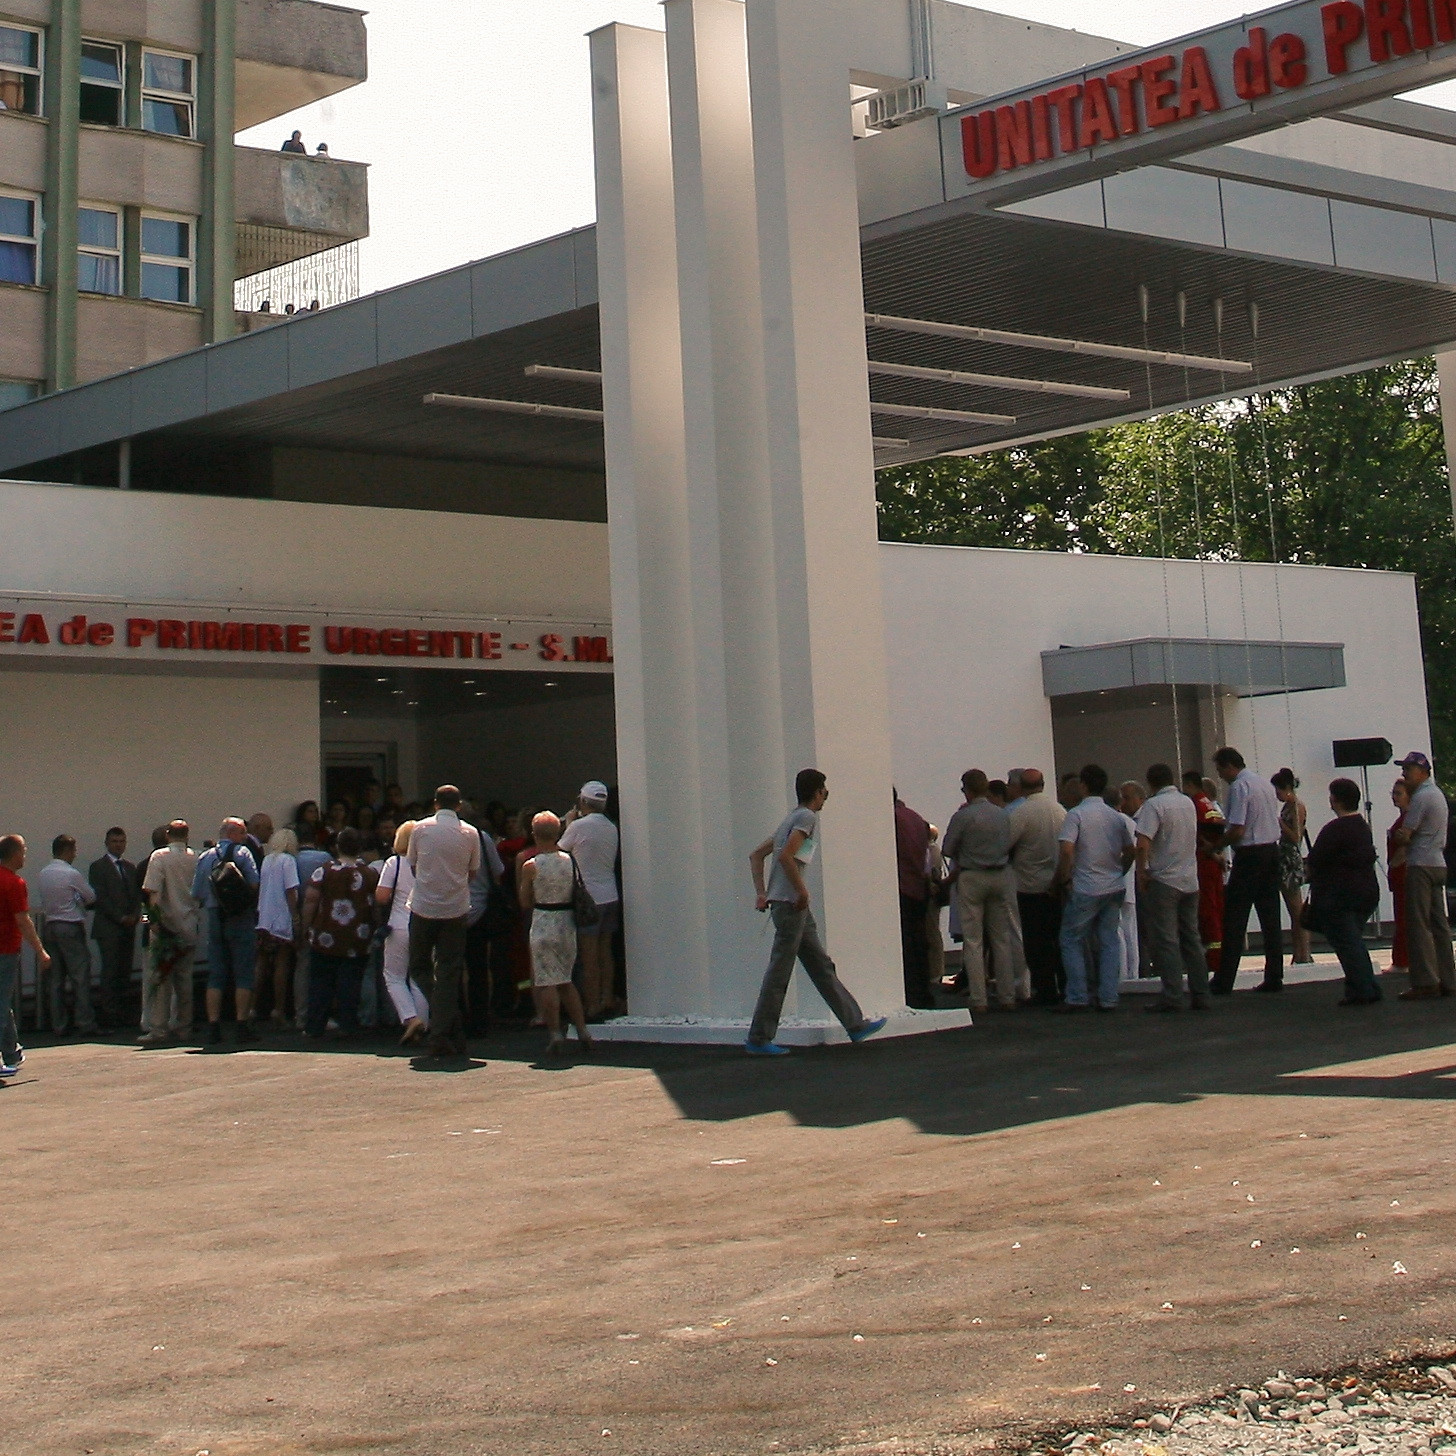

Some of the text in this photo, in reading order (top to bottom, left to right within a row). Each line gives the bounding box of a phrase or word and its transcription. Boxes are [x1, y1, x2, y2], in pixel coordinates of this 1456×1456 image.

[960, 45, 1222, 178] UNITATEA
[1232, 26, 1308, 101] de
[60, 615, 115, 647] de
[127, 617, 312, 654] PRIMIRE
[323, 625, 502, 660] URGENTE
